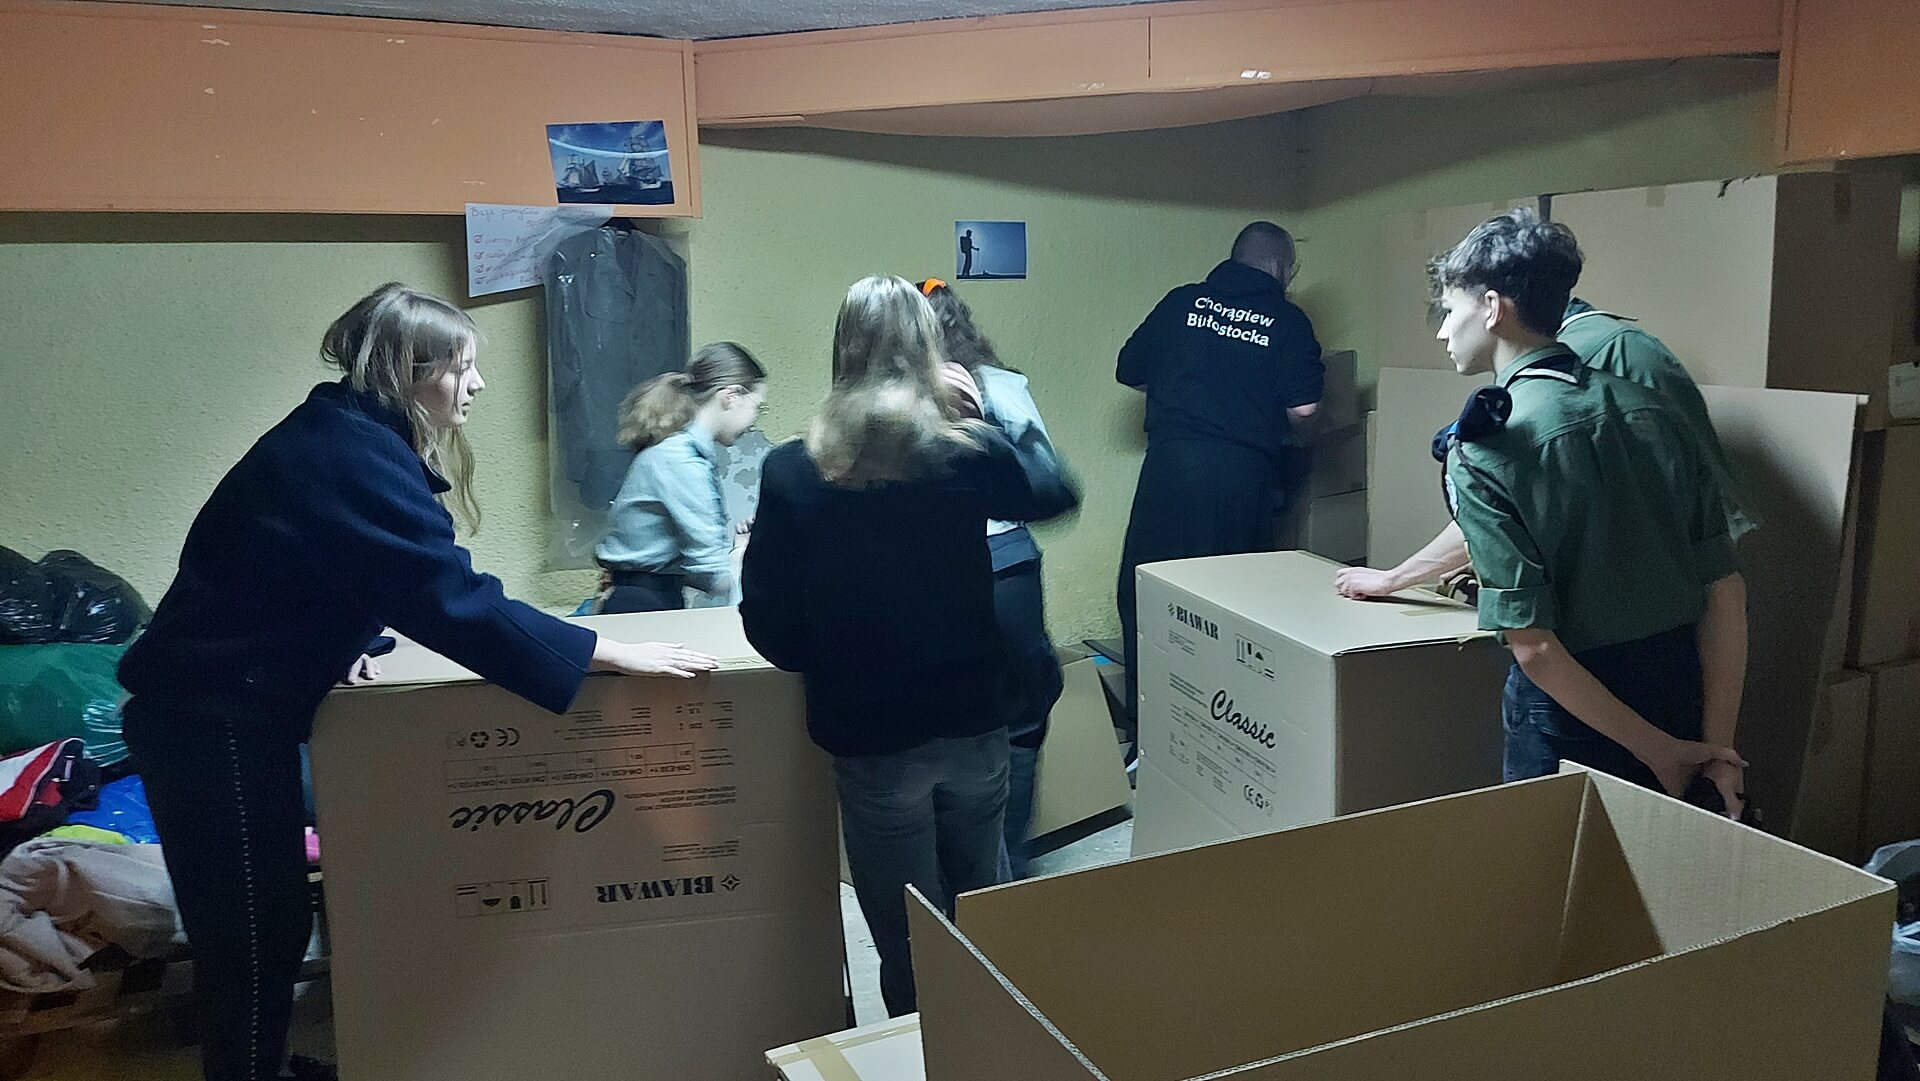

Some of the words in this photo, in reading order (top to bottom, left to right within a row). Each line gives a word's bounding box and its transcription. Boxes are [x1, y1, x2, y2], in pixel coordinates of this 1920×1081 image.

[1176, 605, 1219, 640] BIAWAR
[1211, 689, 1276, 749] Classic
[449, 789, 615, 833] Classic
[595, 875, 715, 903] BIAWAR
